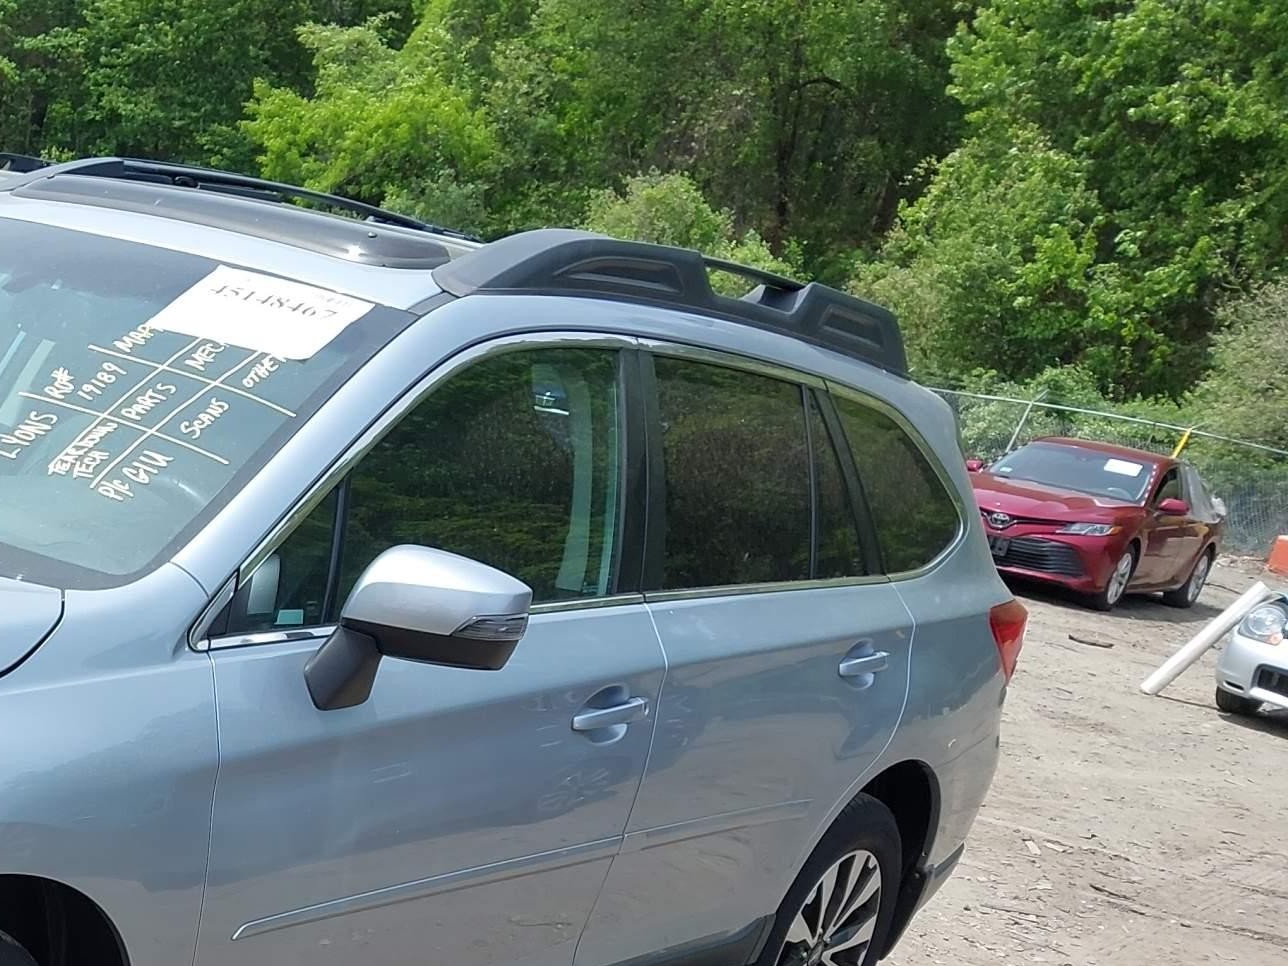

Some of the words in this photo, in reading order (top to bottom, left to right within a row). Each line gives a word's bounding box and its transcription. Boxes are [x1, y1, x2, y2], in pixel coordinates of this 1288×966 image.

[209, 284, 339, 320] 45148467
[184, 343, 229, 371] MEC
[77, 362, 127, 401] 19189
[121, 383, 177, 421] PARTS
[73, 450, 110, 479] TECH
